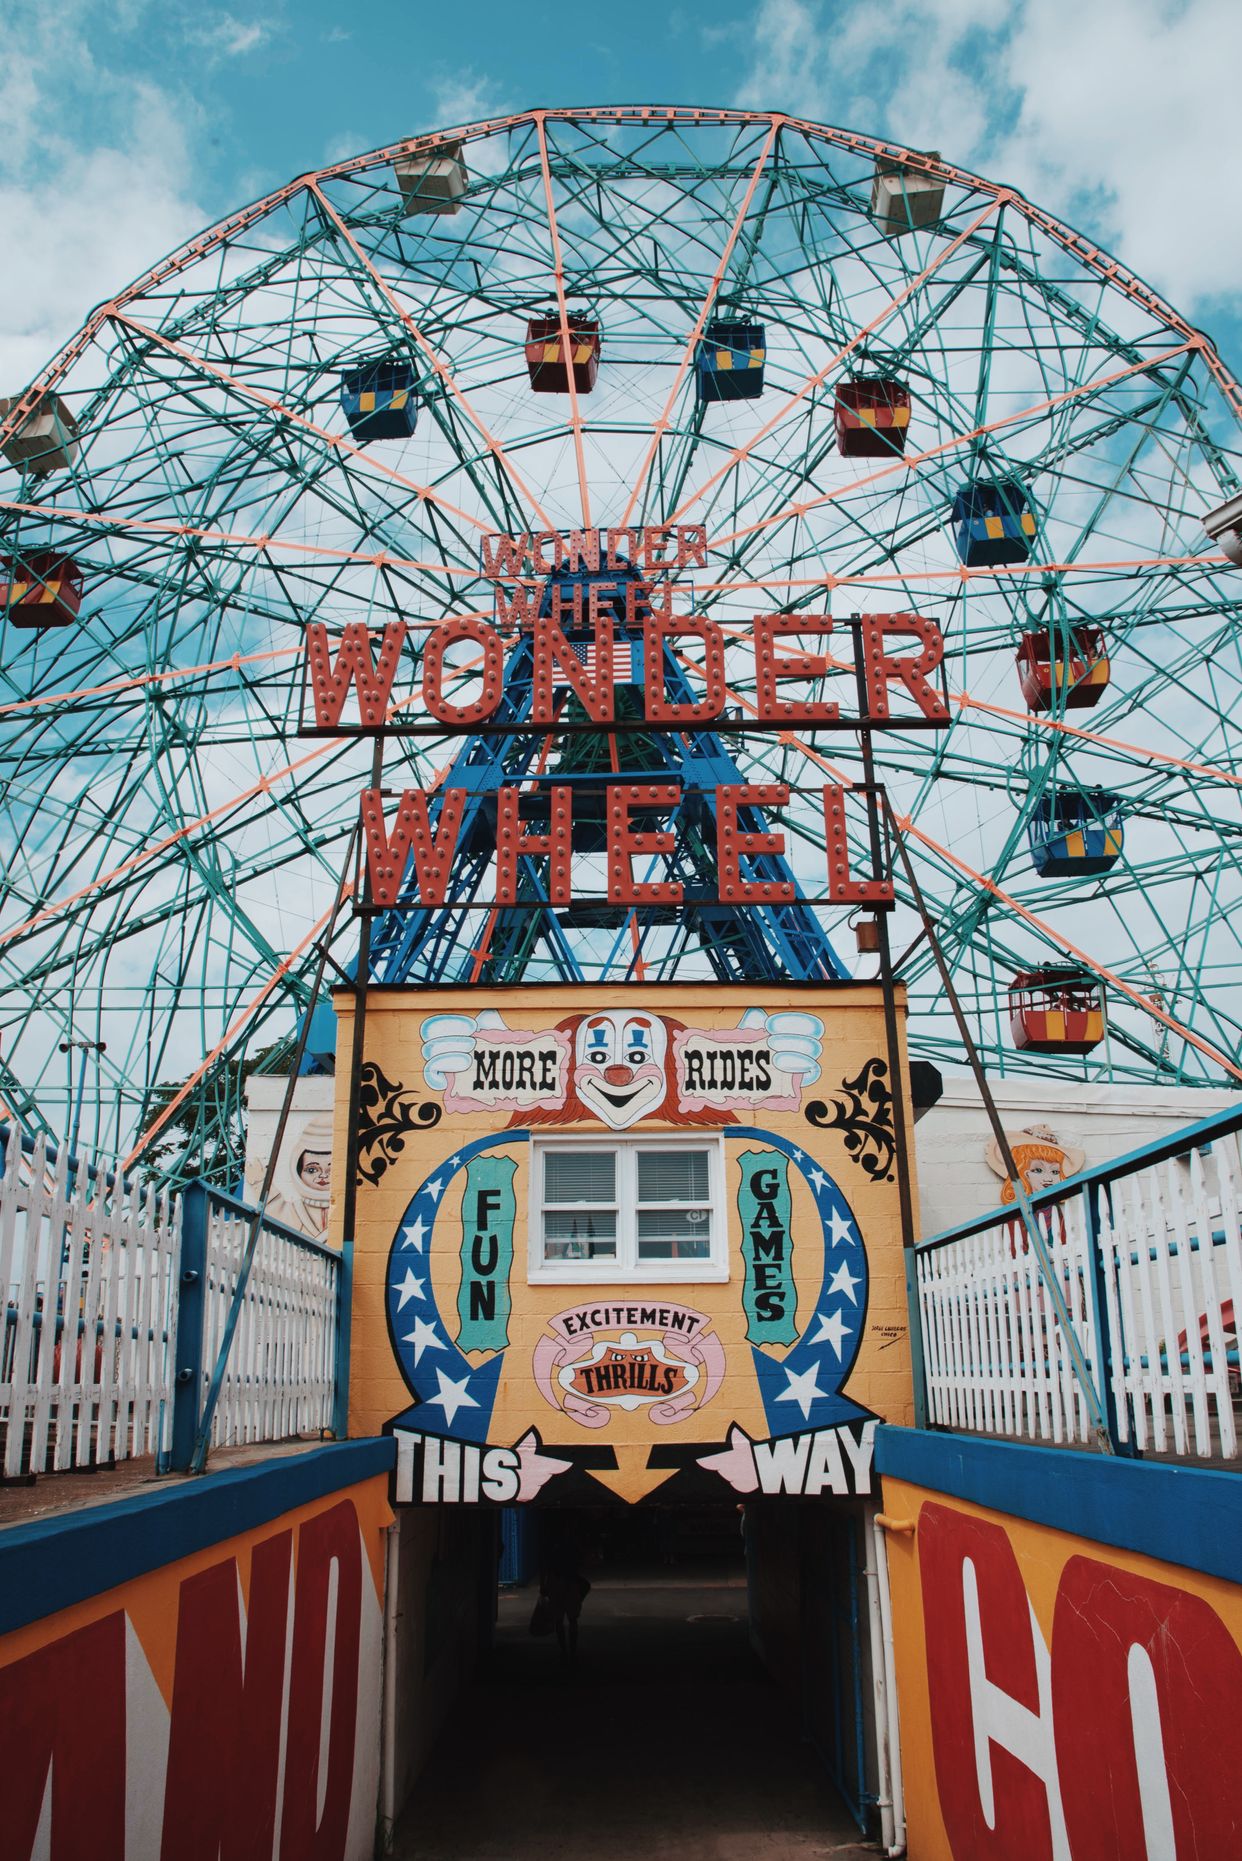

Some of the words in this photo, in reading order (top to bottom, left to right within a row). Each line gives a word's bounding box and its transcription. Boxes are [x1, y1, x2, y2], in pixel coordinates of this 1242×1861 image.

[480, 524, 708, 577] WONDER
[305, 612, 951, 728] WONDER
[360, 783, 894, 906] WHEEL
[472, 1049, 558, 1092] MORE
[684, 1048, 772, 1092] RIDES
[469, 1189, 502, 1322] FUN
[749, 1168, 786, 1323] GAMES
[562, 1306, 701, 1337] EXCITEMENT
[580, 1361, 679, 1395] THRILLS
[392, 1427, 521, 1503] THIS
[752, 1418, 881, 1496] WAY
